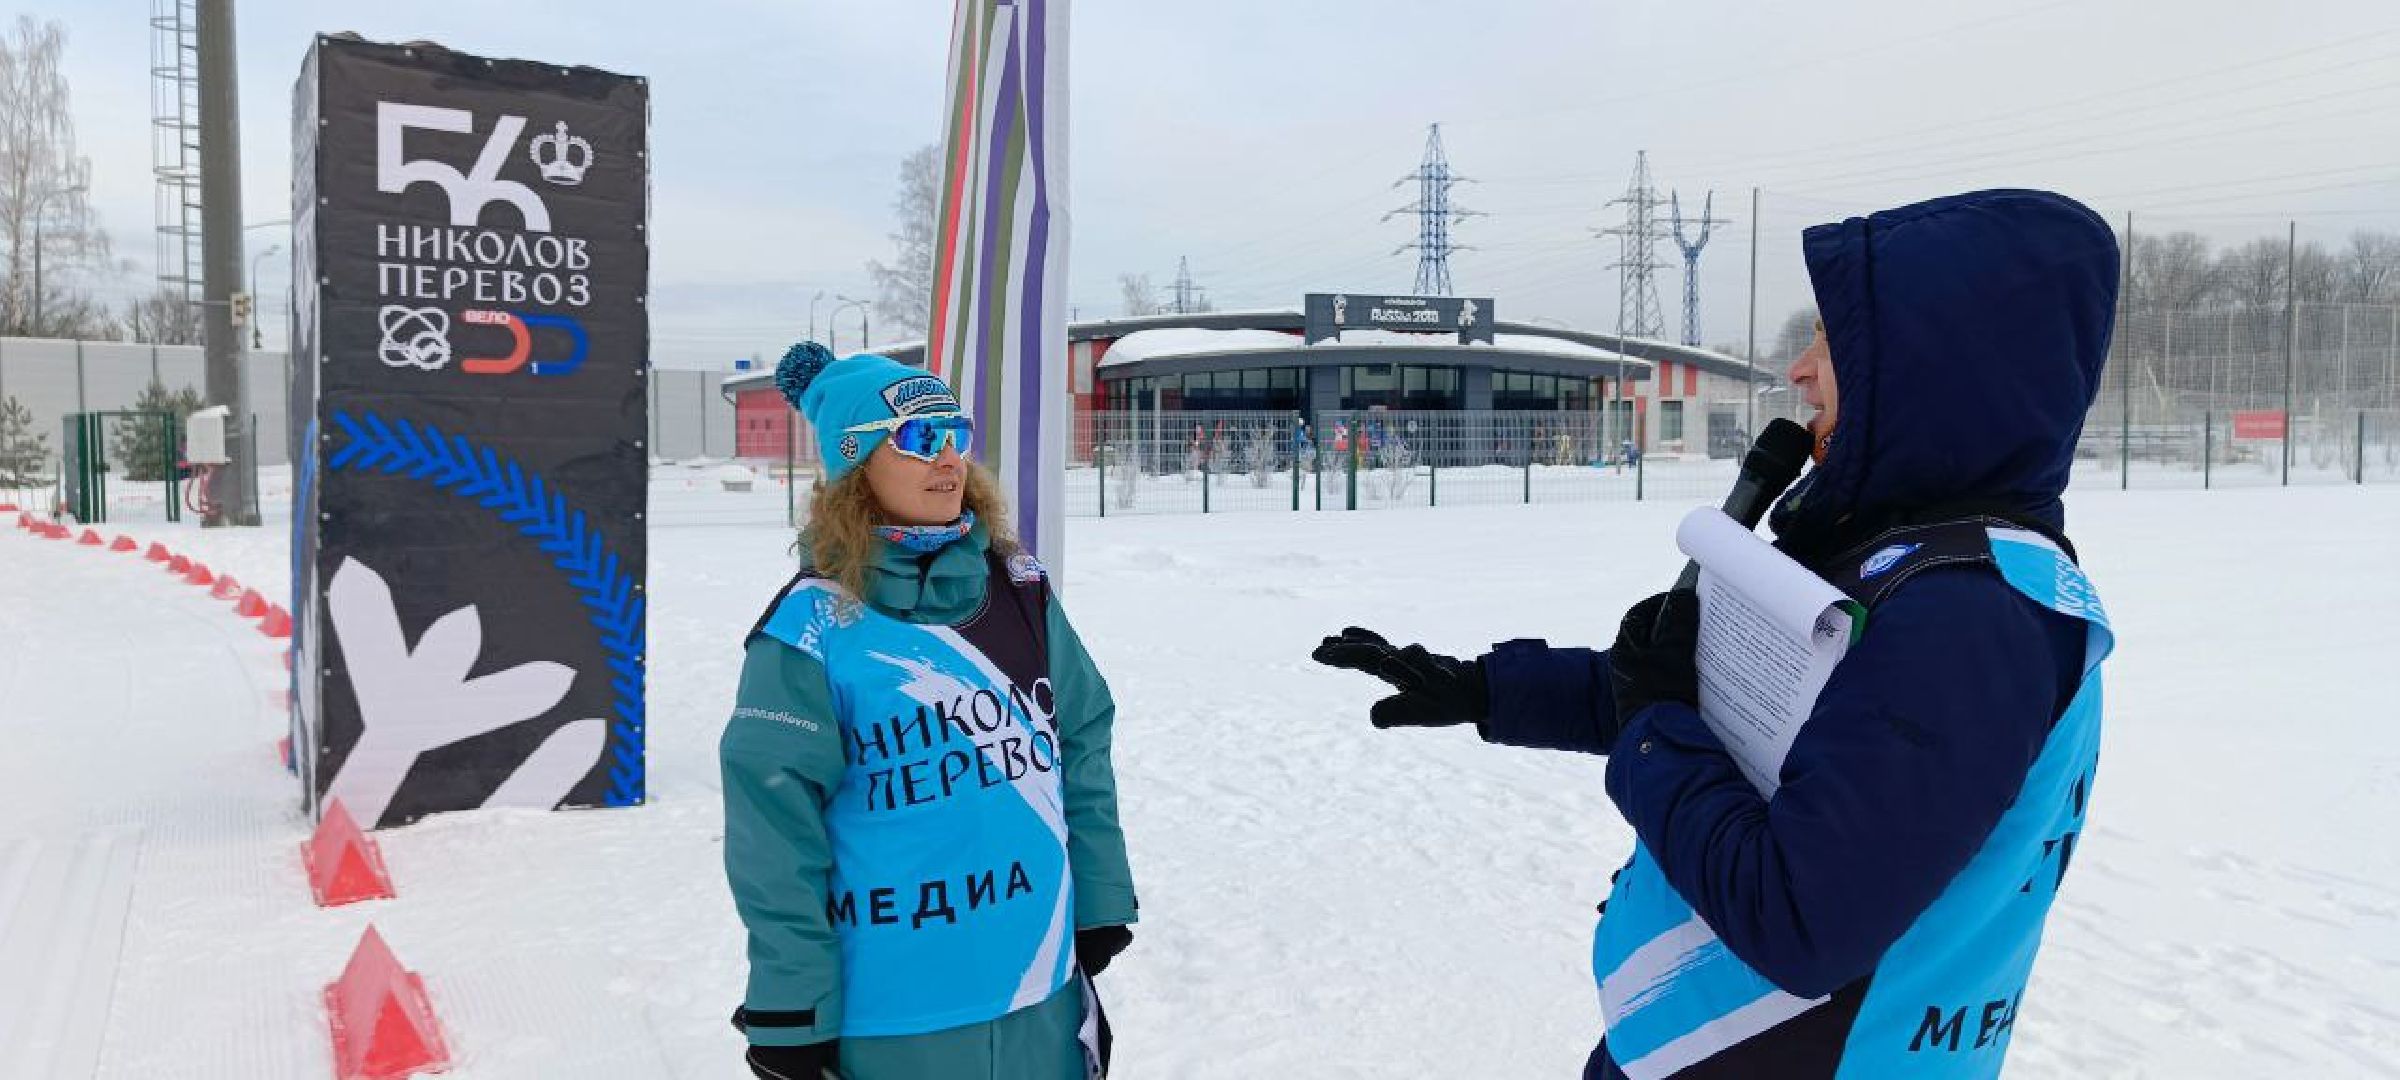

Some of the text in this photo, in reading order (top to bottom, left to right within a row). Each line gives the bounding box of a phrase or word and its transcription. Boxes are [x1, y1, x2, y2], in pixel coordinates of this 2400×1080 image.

[377, 101, 551, 232] 56
[377, 224, 591, 270] НИКОЛОВ
[378, 263, 591, 306] ПЕРЕВОЗ
[852, 678, 1057, 765] НИКОЛО
[867, 731, 1061, 811] ПЕРЕВО
